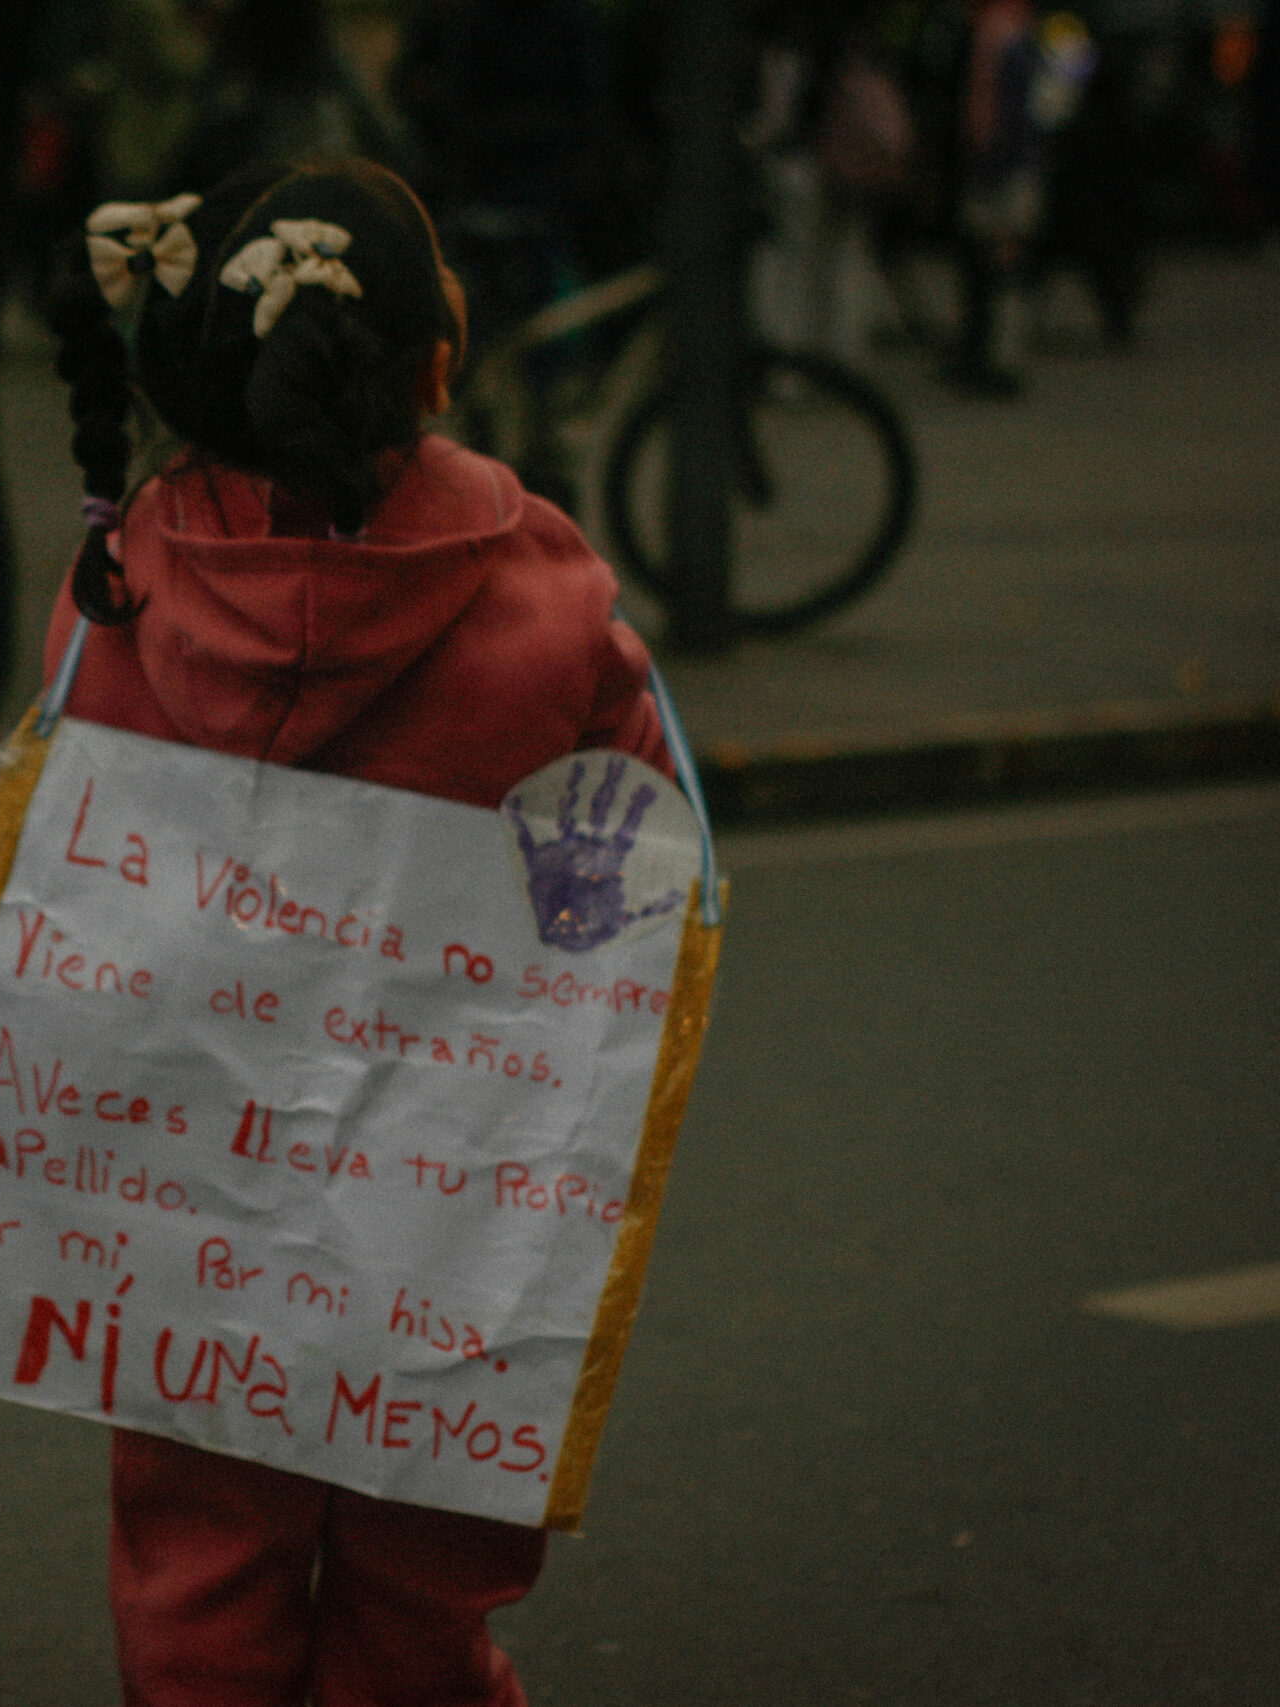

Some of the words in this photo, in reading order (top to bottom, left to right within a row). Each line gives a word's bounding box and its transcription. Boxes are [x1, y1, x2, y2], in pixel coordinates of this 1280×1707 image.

[67, 777, 148, 886] La
[444, 943, 494, 984] no
[209, 979, 280, 1023] de
[324, 1005, 563, 1089] extraños.
[404, 1153, 468, 1196] tu
[198, 1236, 264, 1291] Por
[288, 1272, 349, 1316] mi
[325, 1370, 549, 1482] MENOS.
